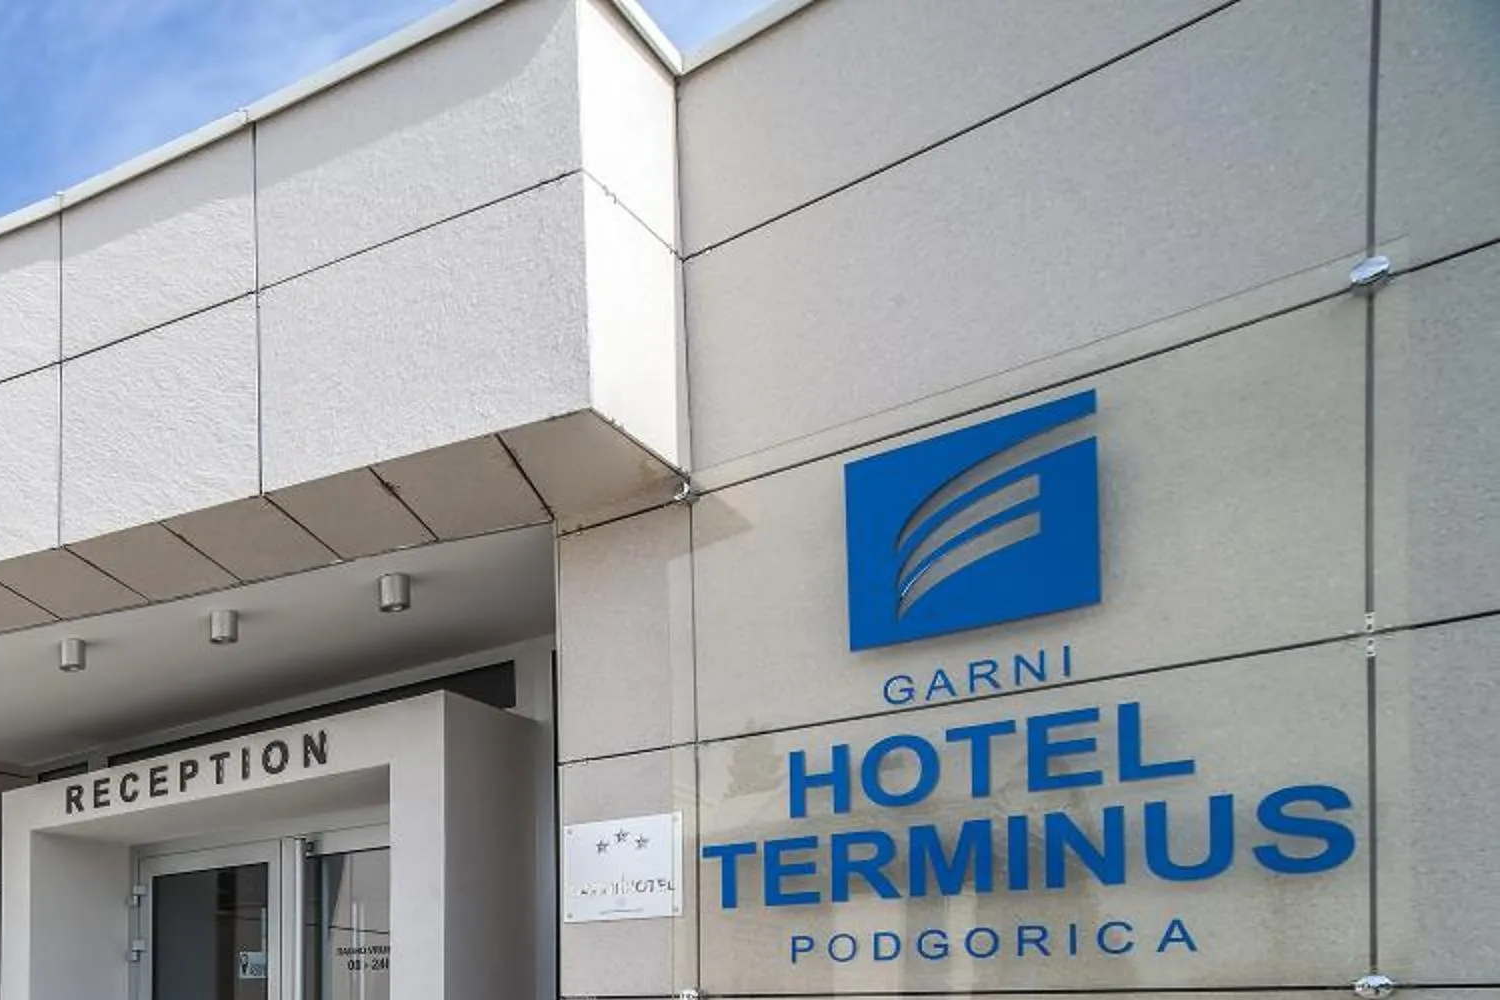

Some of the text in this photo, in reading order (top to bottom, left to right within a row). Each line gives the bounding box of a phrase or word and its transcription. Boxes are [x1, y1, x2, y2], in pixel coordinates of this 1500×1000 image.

[882, 645, 1072, 705] GARNI
[65, 729, 329, 814] RECEPTION
[788, 702, 1197, 819] HOTEL
[702, 784, 1357, 909] TERMINUS
[790, 919, 1198, 963] PODGORICA
